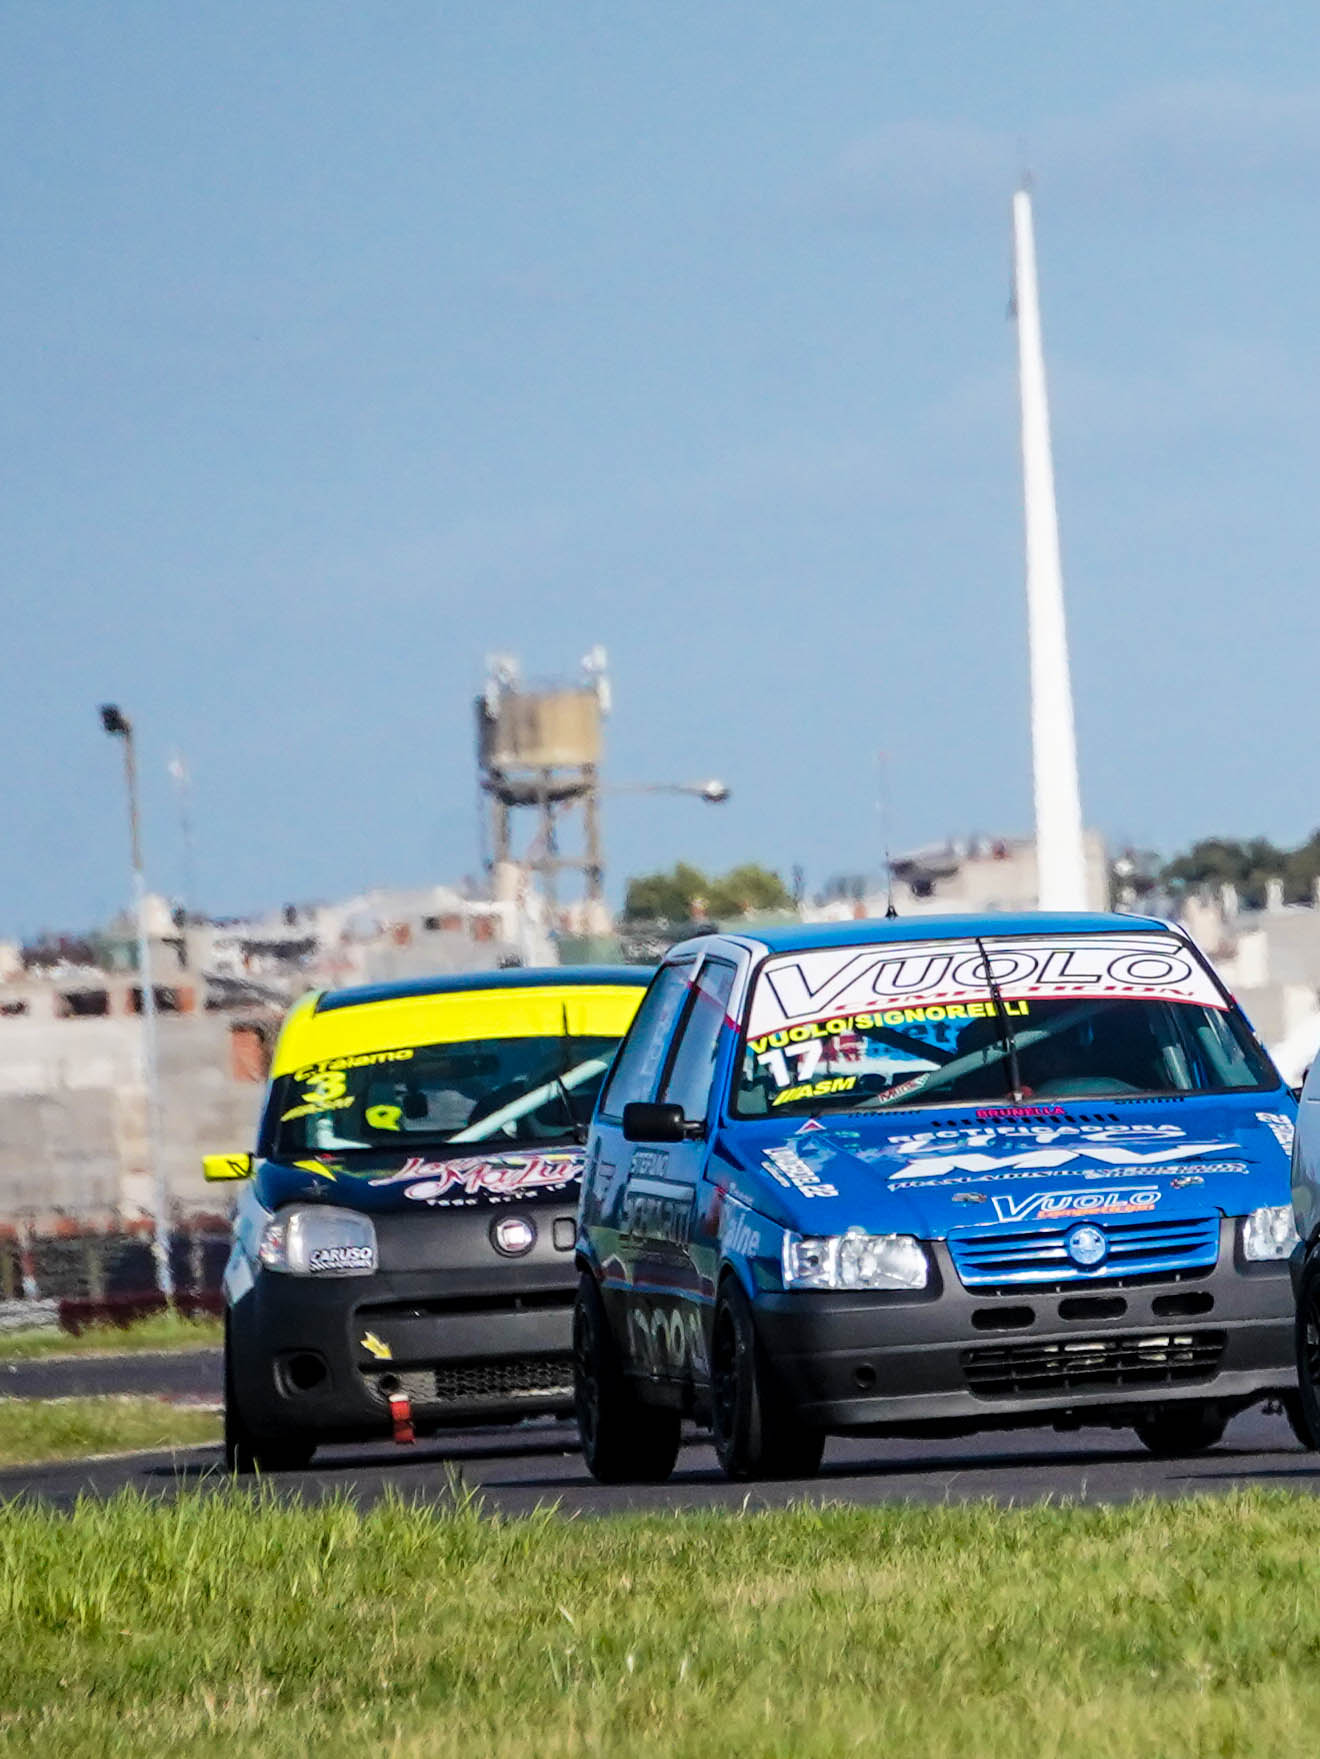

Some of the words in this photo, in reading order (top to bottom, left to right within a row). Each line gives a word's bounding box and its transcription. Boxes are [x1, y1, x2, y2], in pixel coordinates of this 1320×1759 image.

[765, 943, 1192, 1019] VUOLO
[757, 1039, 824, 1089] 17
[301, 1070, 348, 1104] 3
[991, 1185, 1162, 1223] VUOLO
